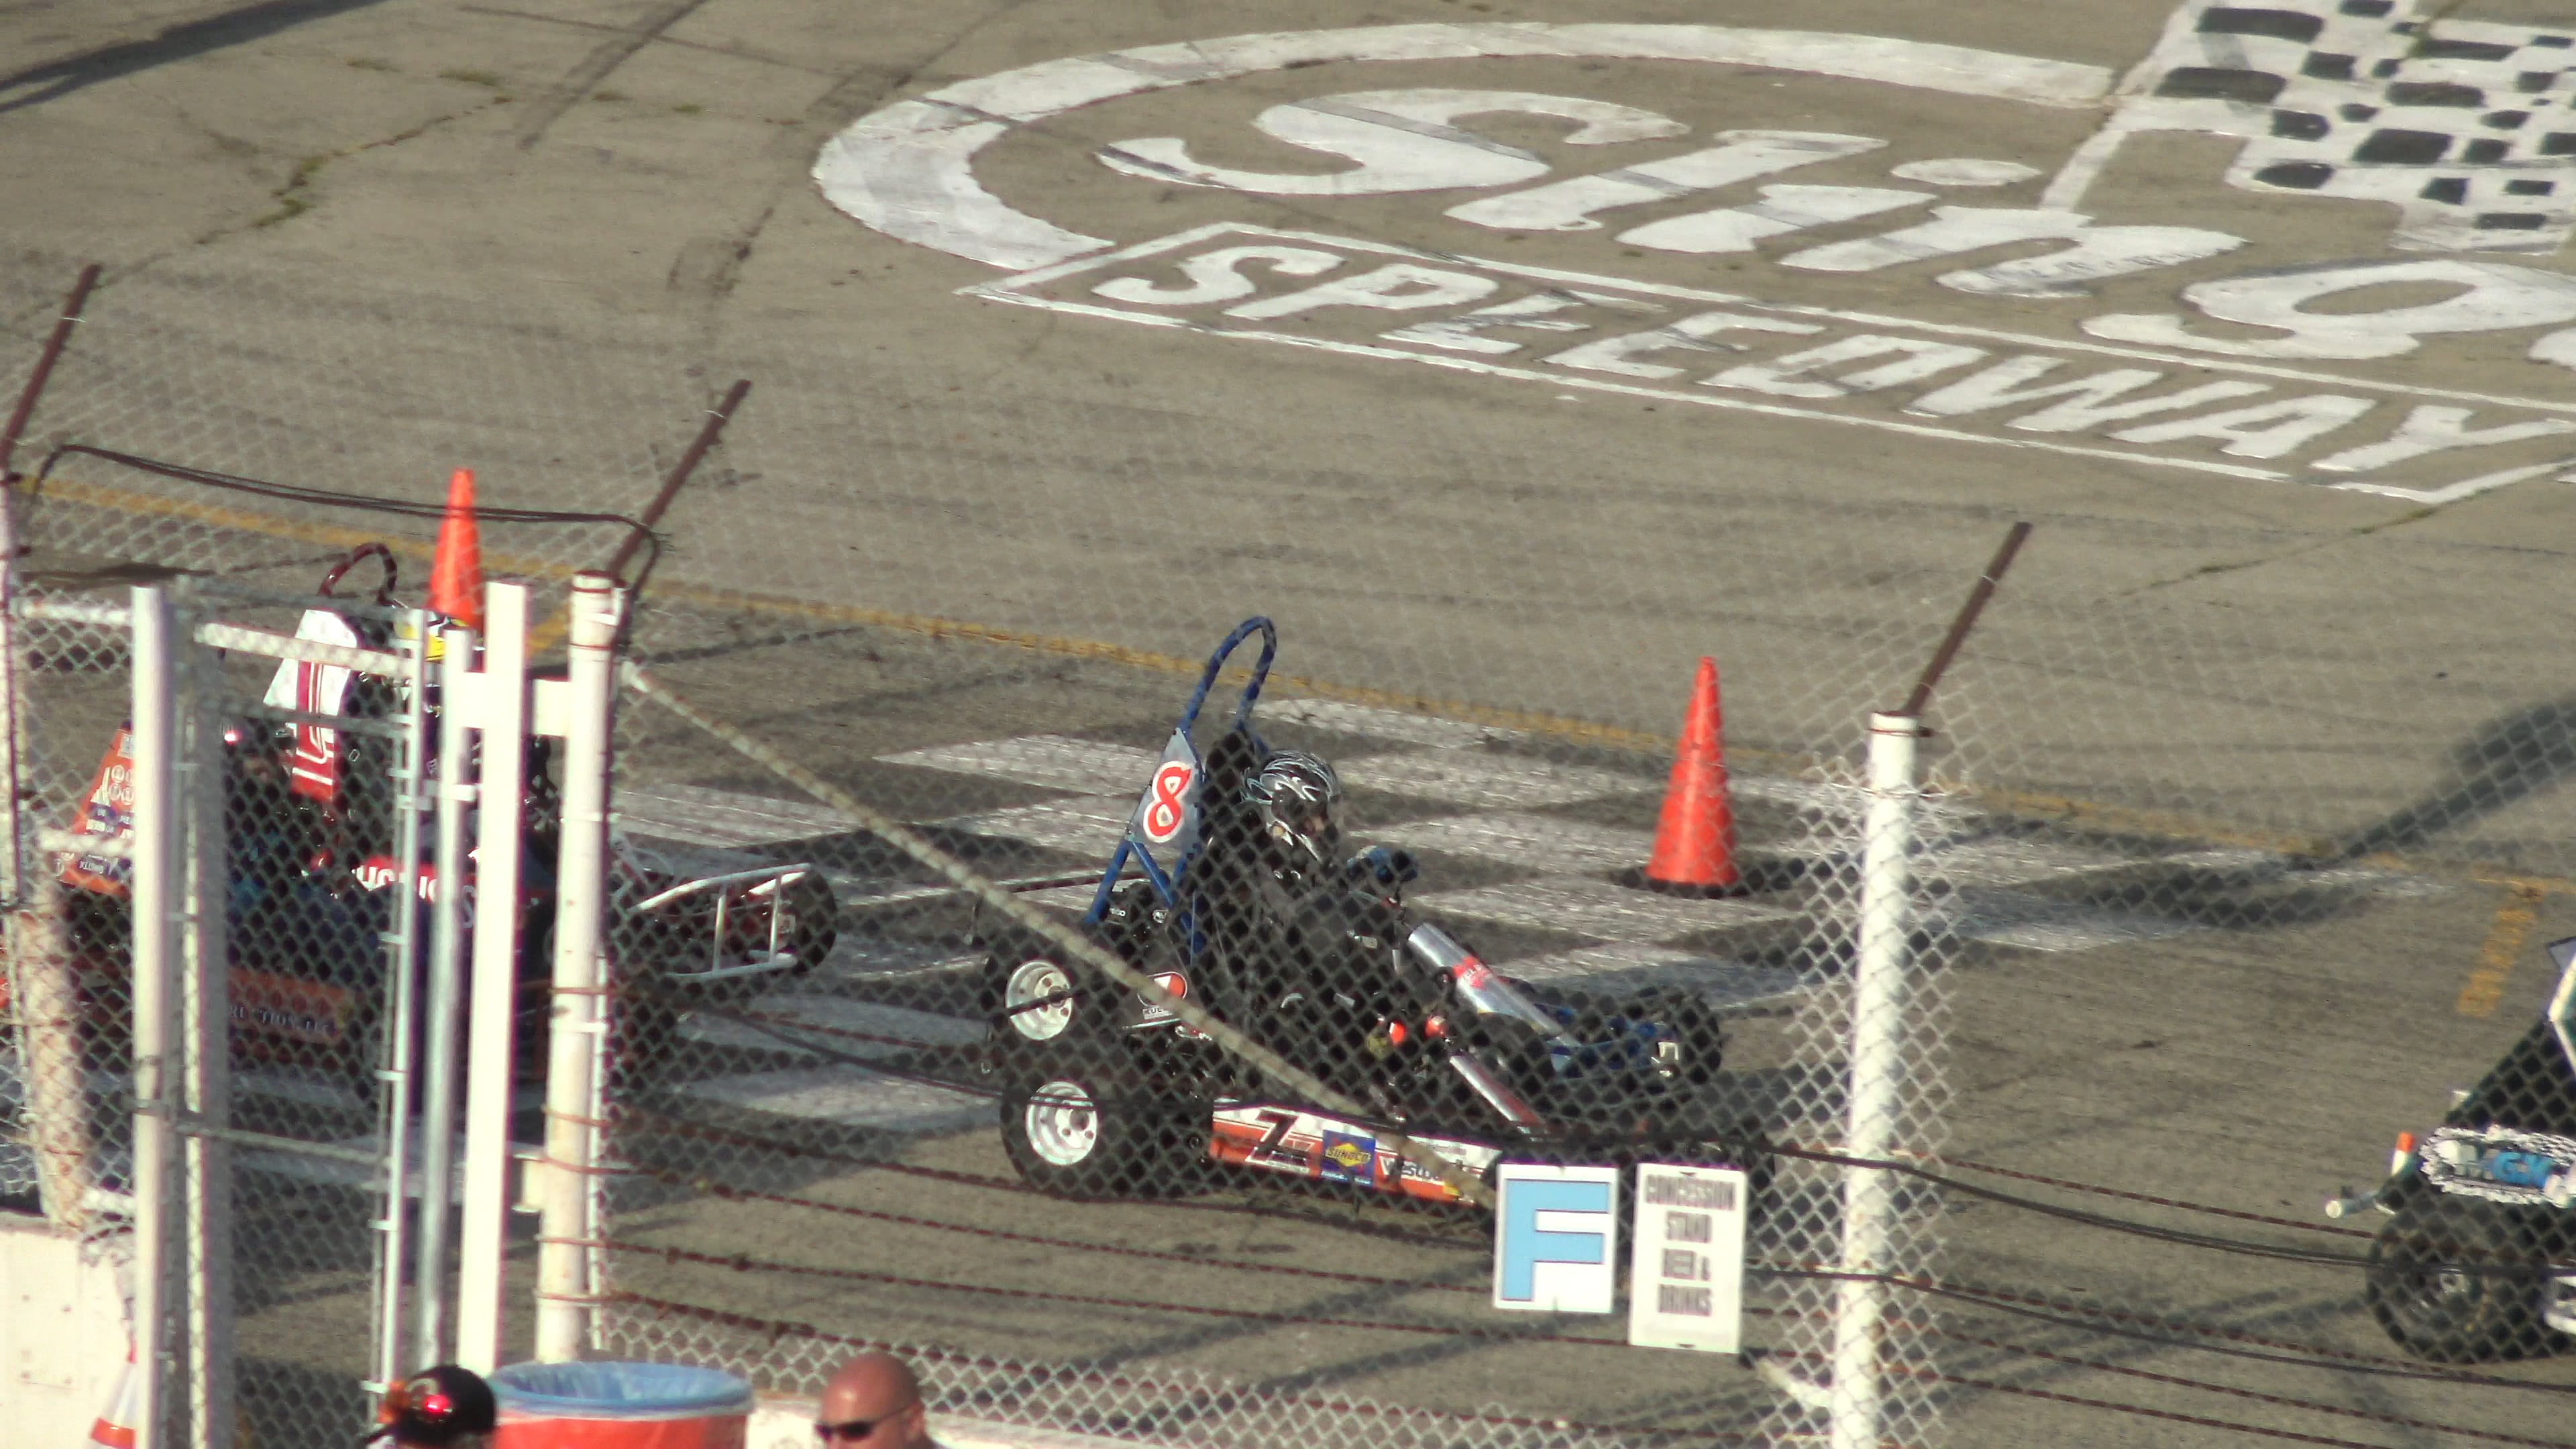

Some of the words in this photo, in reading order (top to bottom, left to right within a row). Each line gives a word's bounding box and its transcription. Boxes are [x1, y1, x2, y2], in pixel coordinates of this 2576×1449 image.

[1097, 88, 2576, 360] Sling
[1091, 242, 2576, 472] SPEEDWAY
[1143, 761, 1193, 843] 8
[1502, 1179, 1611, 1301] F
